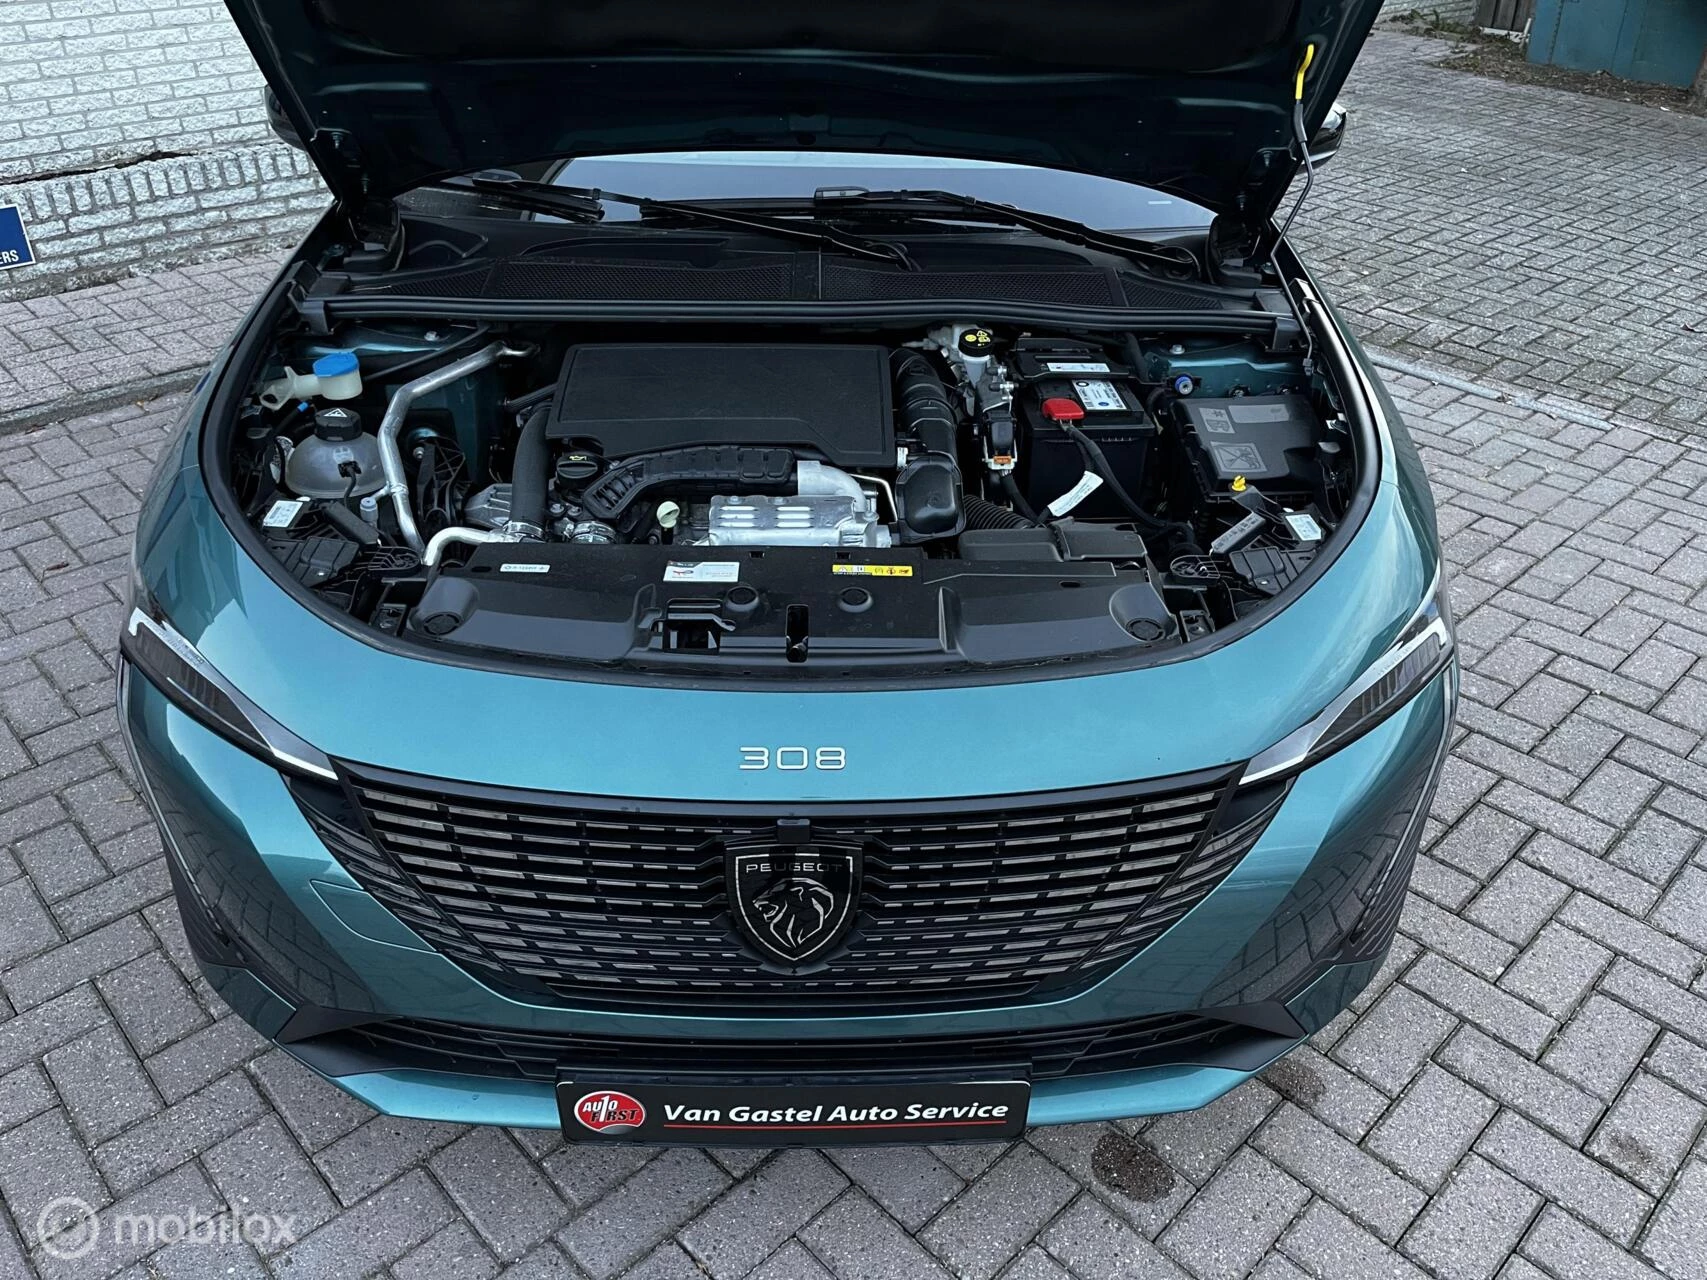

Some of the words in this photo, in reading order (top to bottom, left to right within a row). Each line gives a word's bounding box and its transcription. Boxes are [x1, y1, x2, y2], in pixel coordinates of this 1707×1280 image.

[739, 746, 846, 770] 308
[745, 862, 842, 873] PEUGEOT
[663, 1104, 721, 1122] Van
[728, 1105, 823, 1123] Gastel
[826, 1104, 898, 1121] Auto
[904, 1102, 1009, 1120] Service
